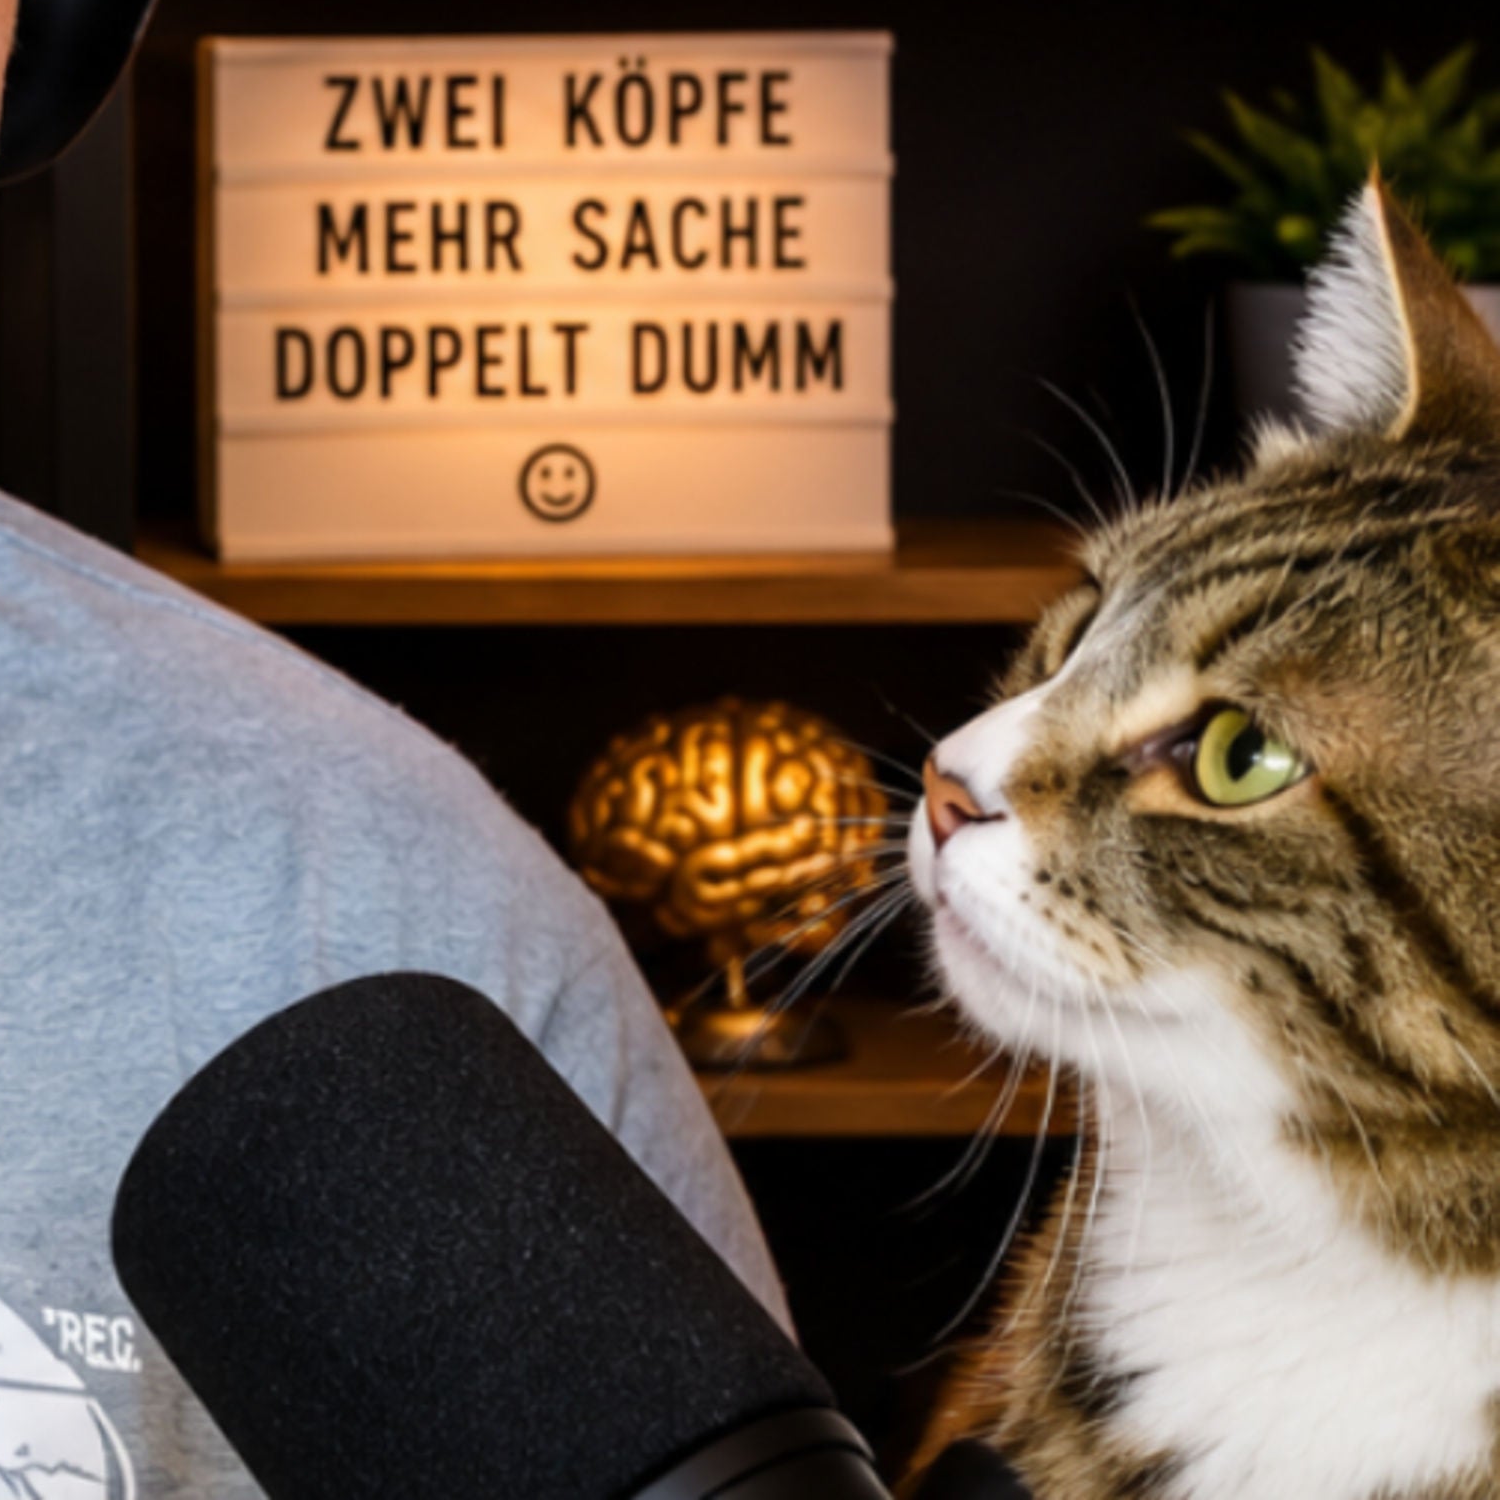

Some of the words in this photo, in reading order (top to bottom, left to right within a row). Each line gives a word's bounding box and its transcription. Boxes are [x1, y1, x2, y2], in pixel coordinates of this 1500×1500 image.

[321, 73, 507, 153] ZWEI
[563, 55, 794, 149] KÖPFE
[316, 201, 524, 276] MEHR
[571, 195, 807, 272] SACHE
[273, 323, 590, 402] DOPPELT
[631, 319, 845, 396] DUMM
